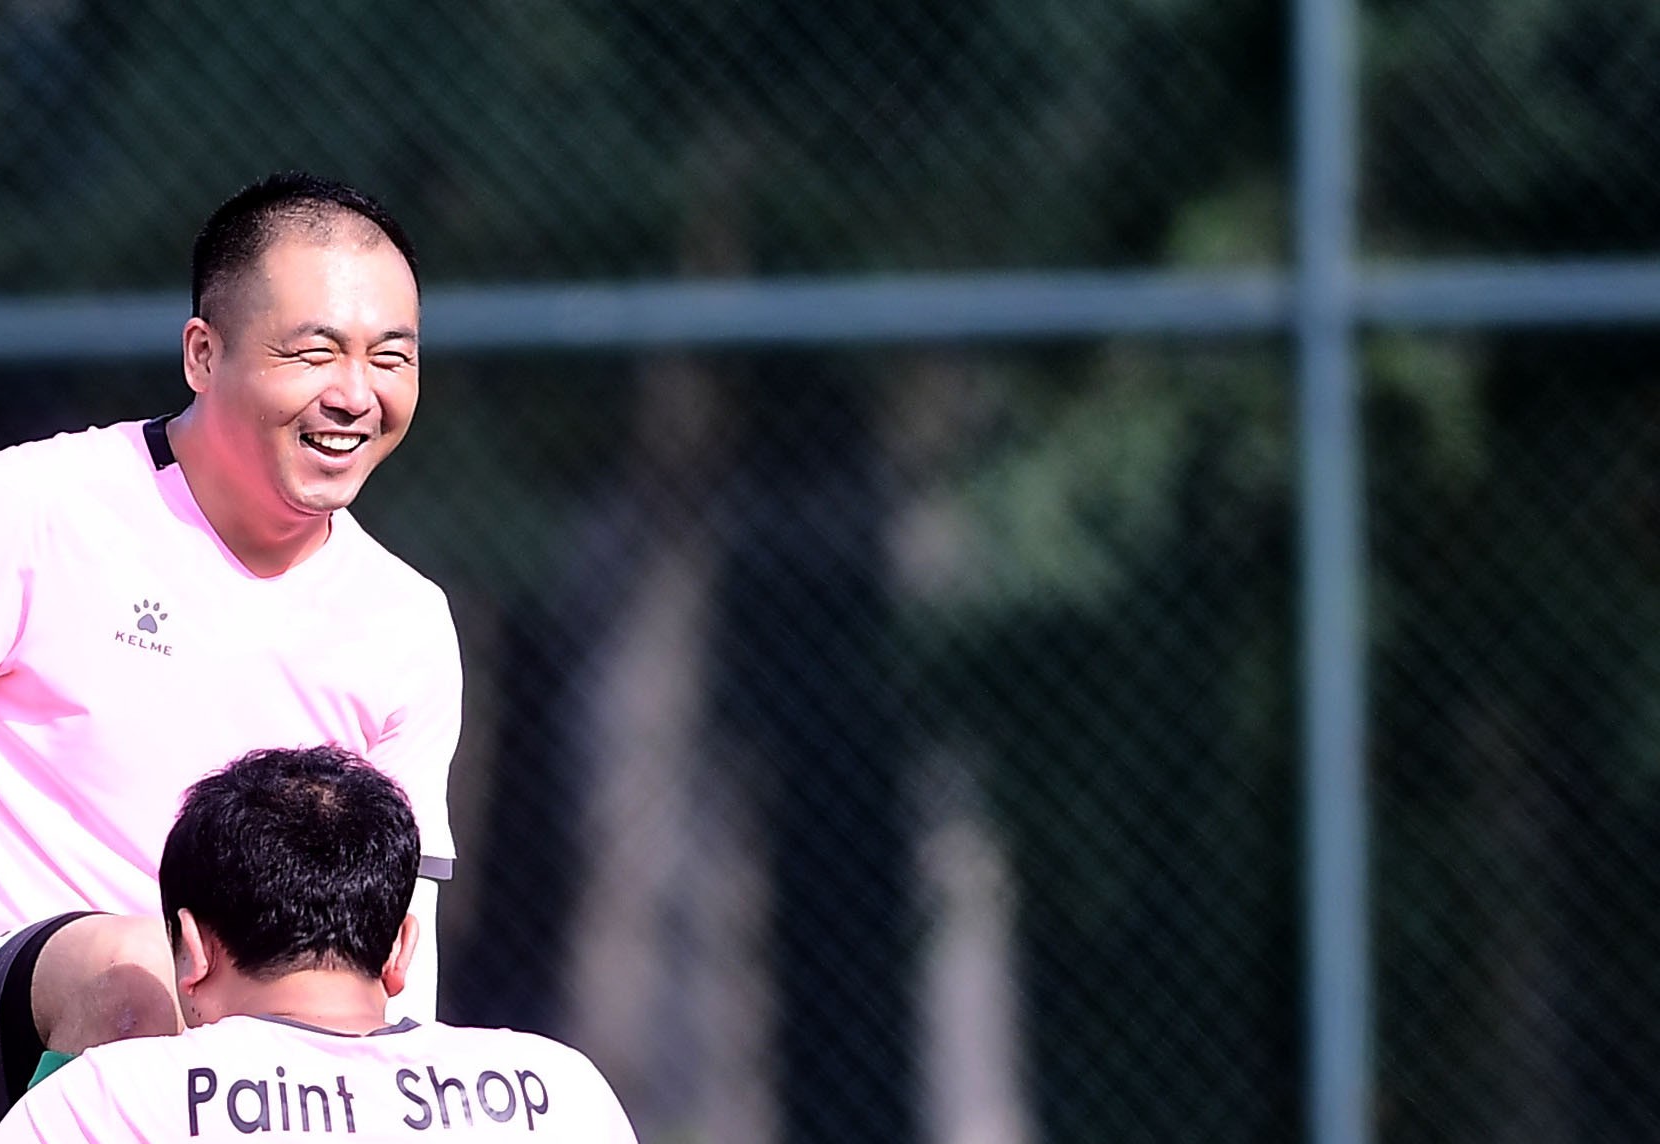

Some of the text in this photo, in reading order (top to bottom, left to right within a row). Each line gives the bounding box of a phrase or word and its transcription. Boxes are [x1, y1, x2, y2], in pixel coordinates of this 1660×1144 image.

[114, 630, 172, 656] KELME
[187, 1065, 548, 1136] Paint Shop
